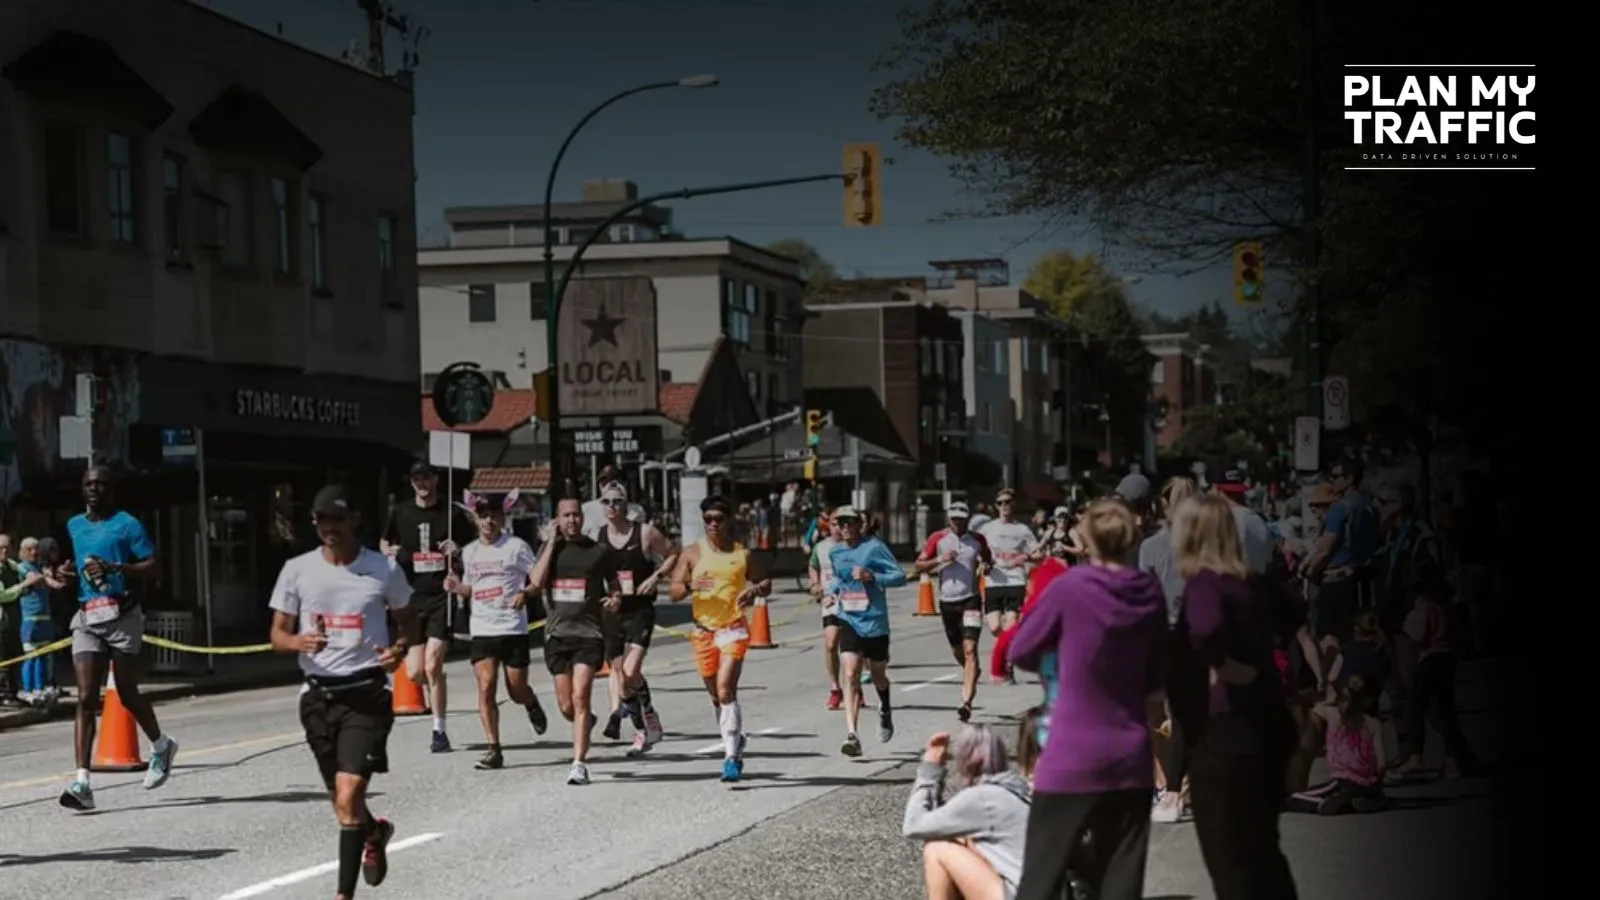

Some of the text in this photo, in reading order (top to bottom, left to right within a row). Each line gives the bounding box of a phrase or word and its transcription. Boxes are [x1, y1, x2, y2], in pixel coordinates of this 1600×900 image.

[563, 361, 646, 385] LOCAL
[236, 388, 360, 425] STARBUCKS COFFEE
[612, 429, 634, 440] YOU
[574, 440, 639, 453] WERE BEER
